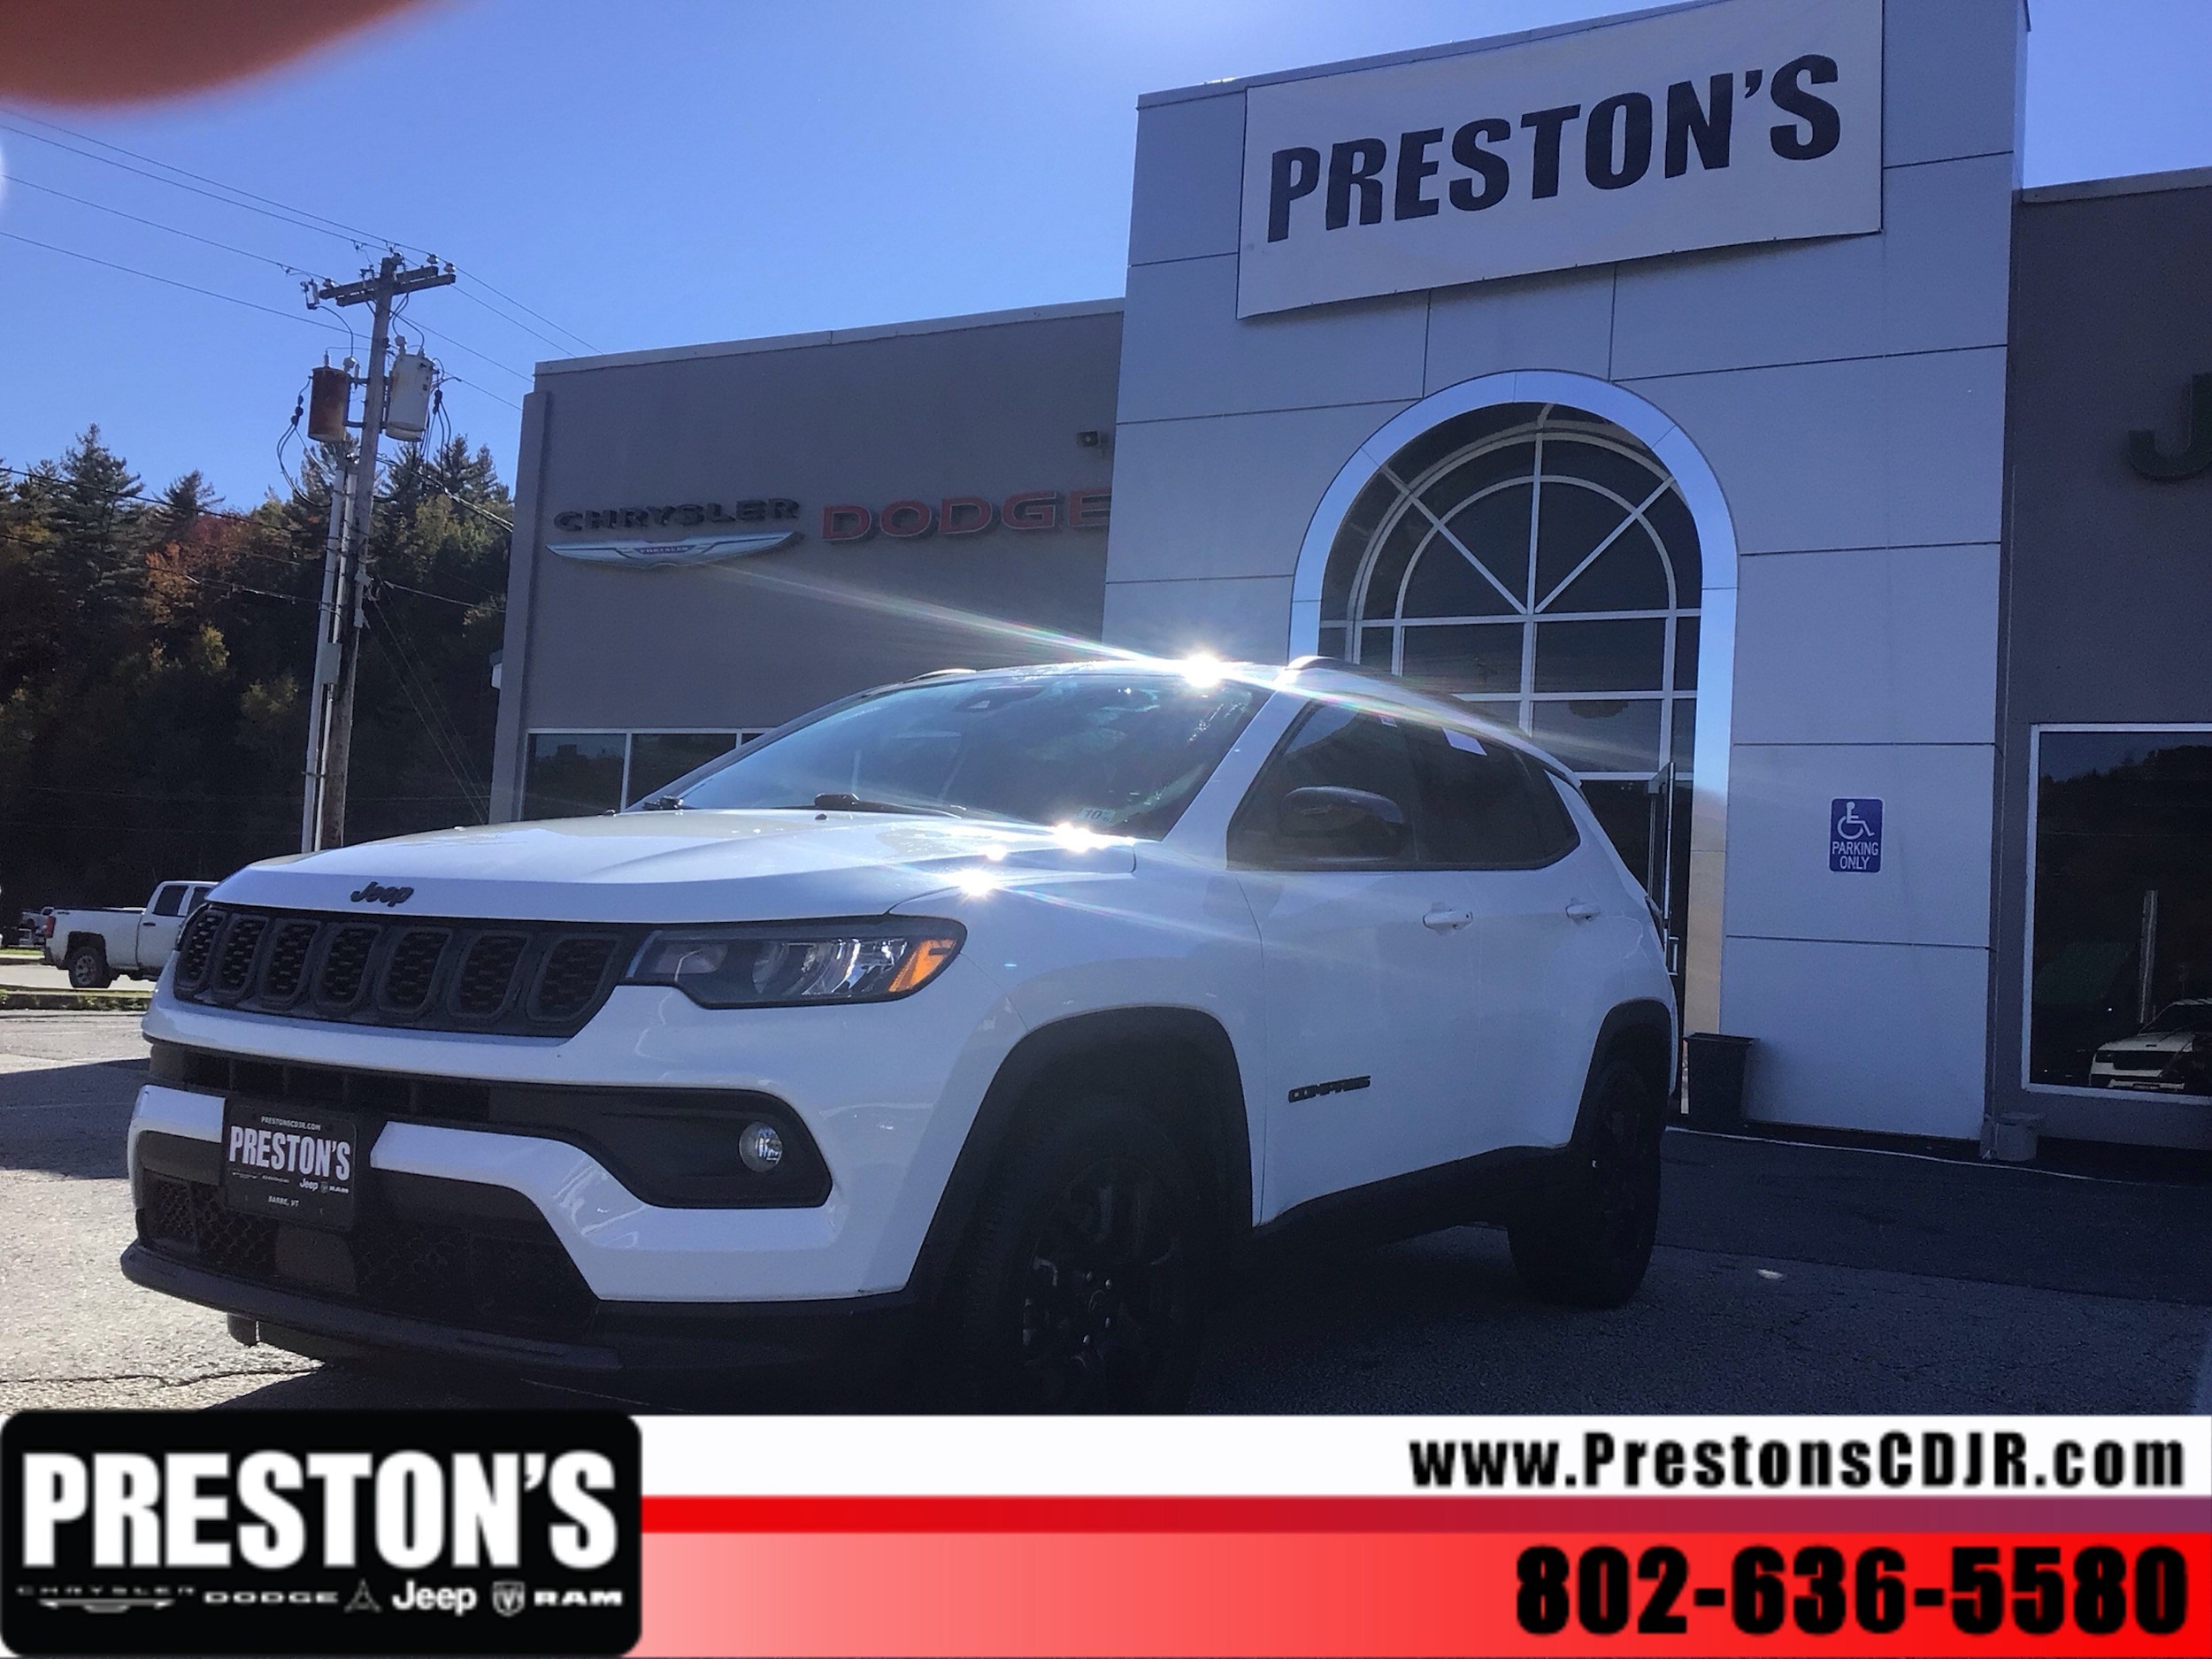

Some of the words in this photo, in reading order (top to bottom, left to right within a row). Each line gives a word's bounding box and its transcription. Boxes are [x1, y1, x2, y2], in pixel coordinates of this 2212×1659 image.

[1267, 54, 1841, 243] PRESTON'S
[553, 498, 799, 531] CHRYSLER
[821, 489, 1112, 542] DODGE
[1832, 841, 1879, 856] PARKING
[1839, 855, 1870, 870] ONLY
[350, 881, 414, 908] Jeep
[1288, 1075, 1371, 1103] COMPASS
[229, 1125, 350, 1181] PRESTON'S
[299, 1178, 319, 1192] Jeep
